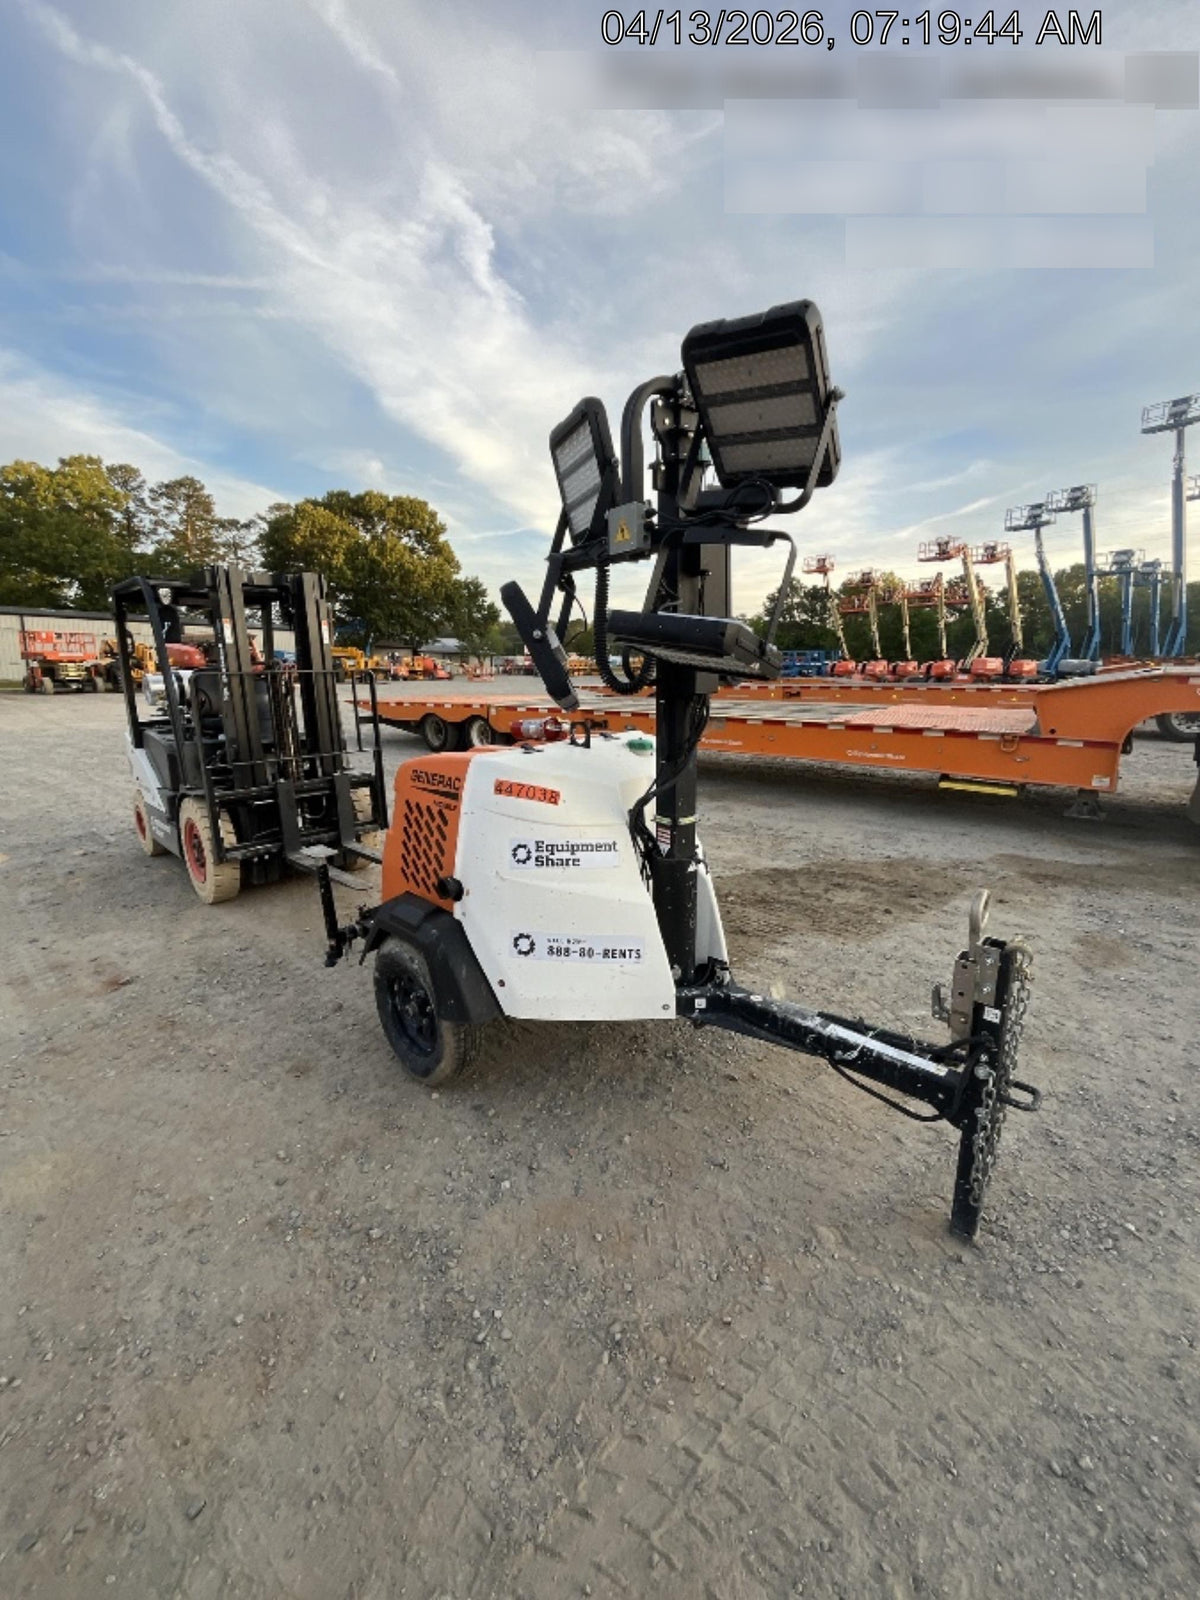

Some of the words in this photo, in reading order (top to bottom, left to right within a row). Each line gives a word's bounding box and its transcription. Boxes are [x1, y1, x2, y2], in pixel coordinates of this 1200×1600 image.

[411, 769, 461, 791] GENERAC
[495, 779, 559, 805] 447038
[535, 841, 618, 856] Equipment
[535, 855, 580, 867] Share
